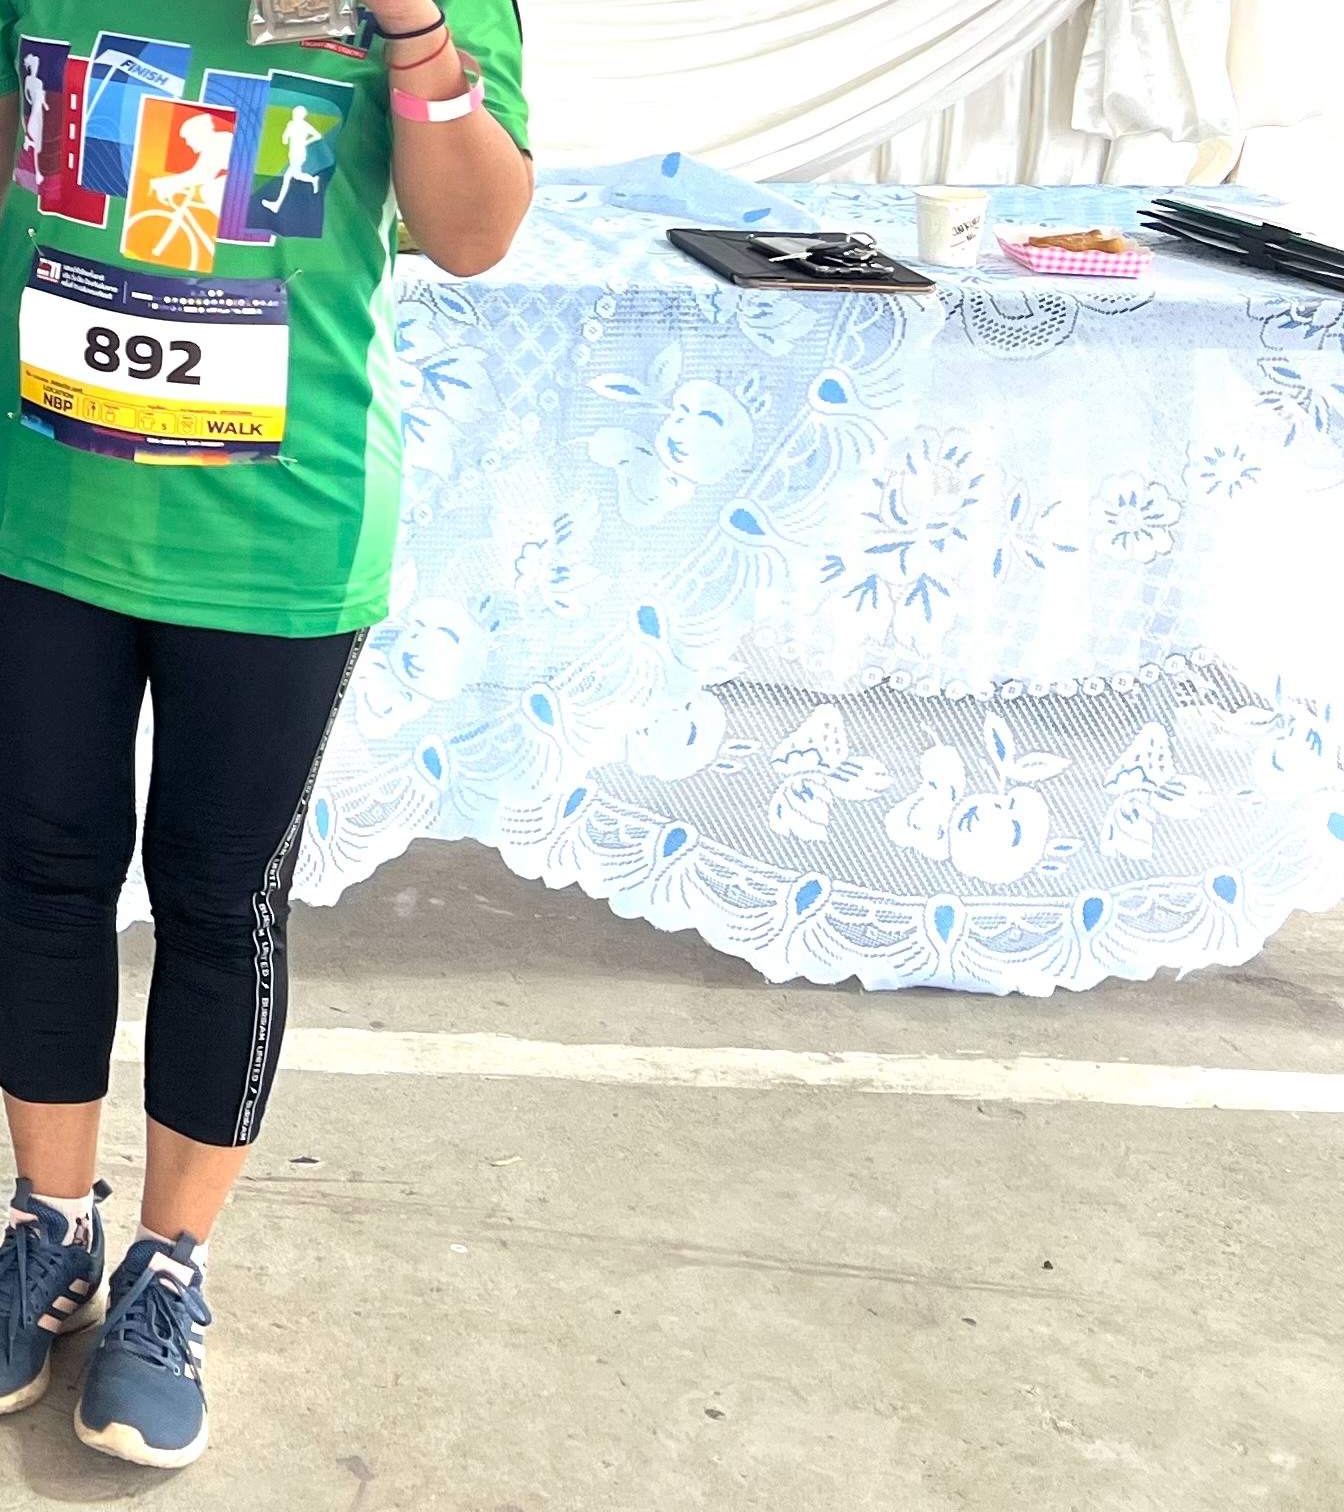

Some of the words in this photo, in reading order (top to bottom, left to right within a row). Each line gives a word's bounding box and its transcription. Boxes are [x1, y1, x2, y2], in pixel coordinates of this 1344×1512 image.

[120, 59, 168, 86] FINISH
[83, 326, 202, 385] 892
[43, 392, 73, 412] NBP
[207, 420, 263, 436] WALK
